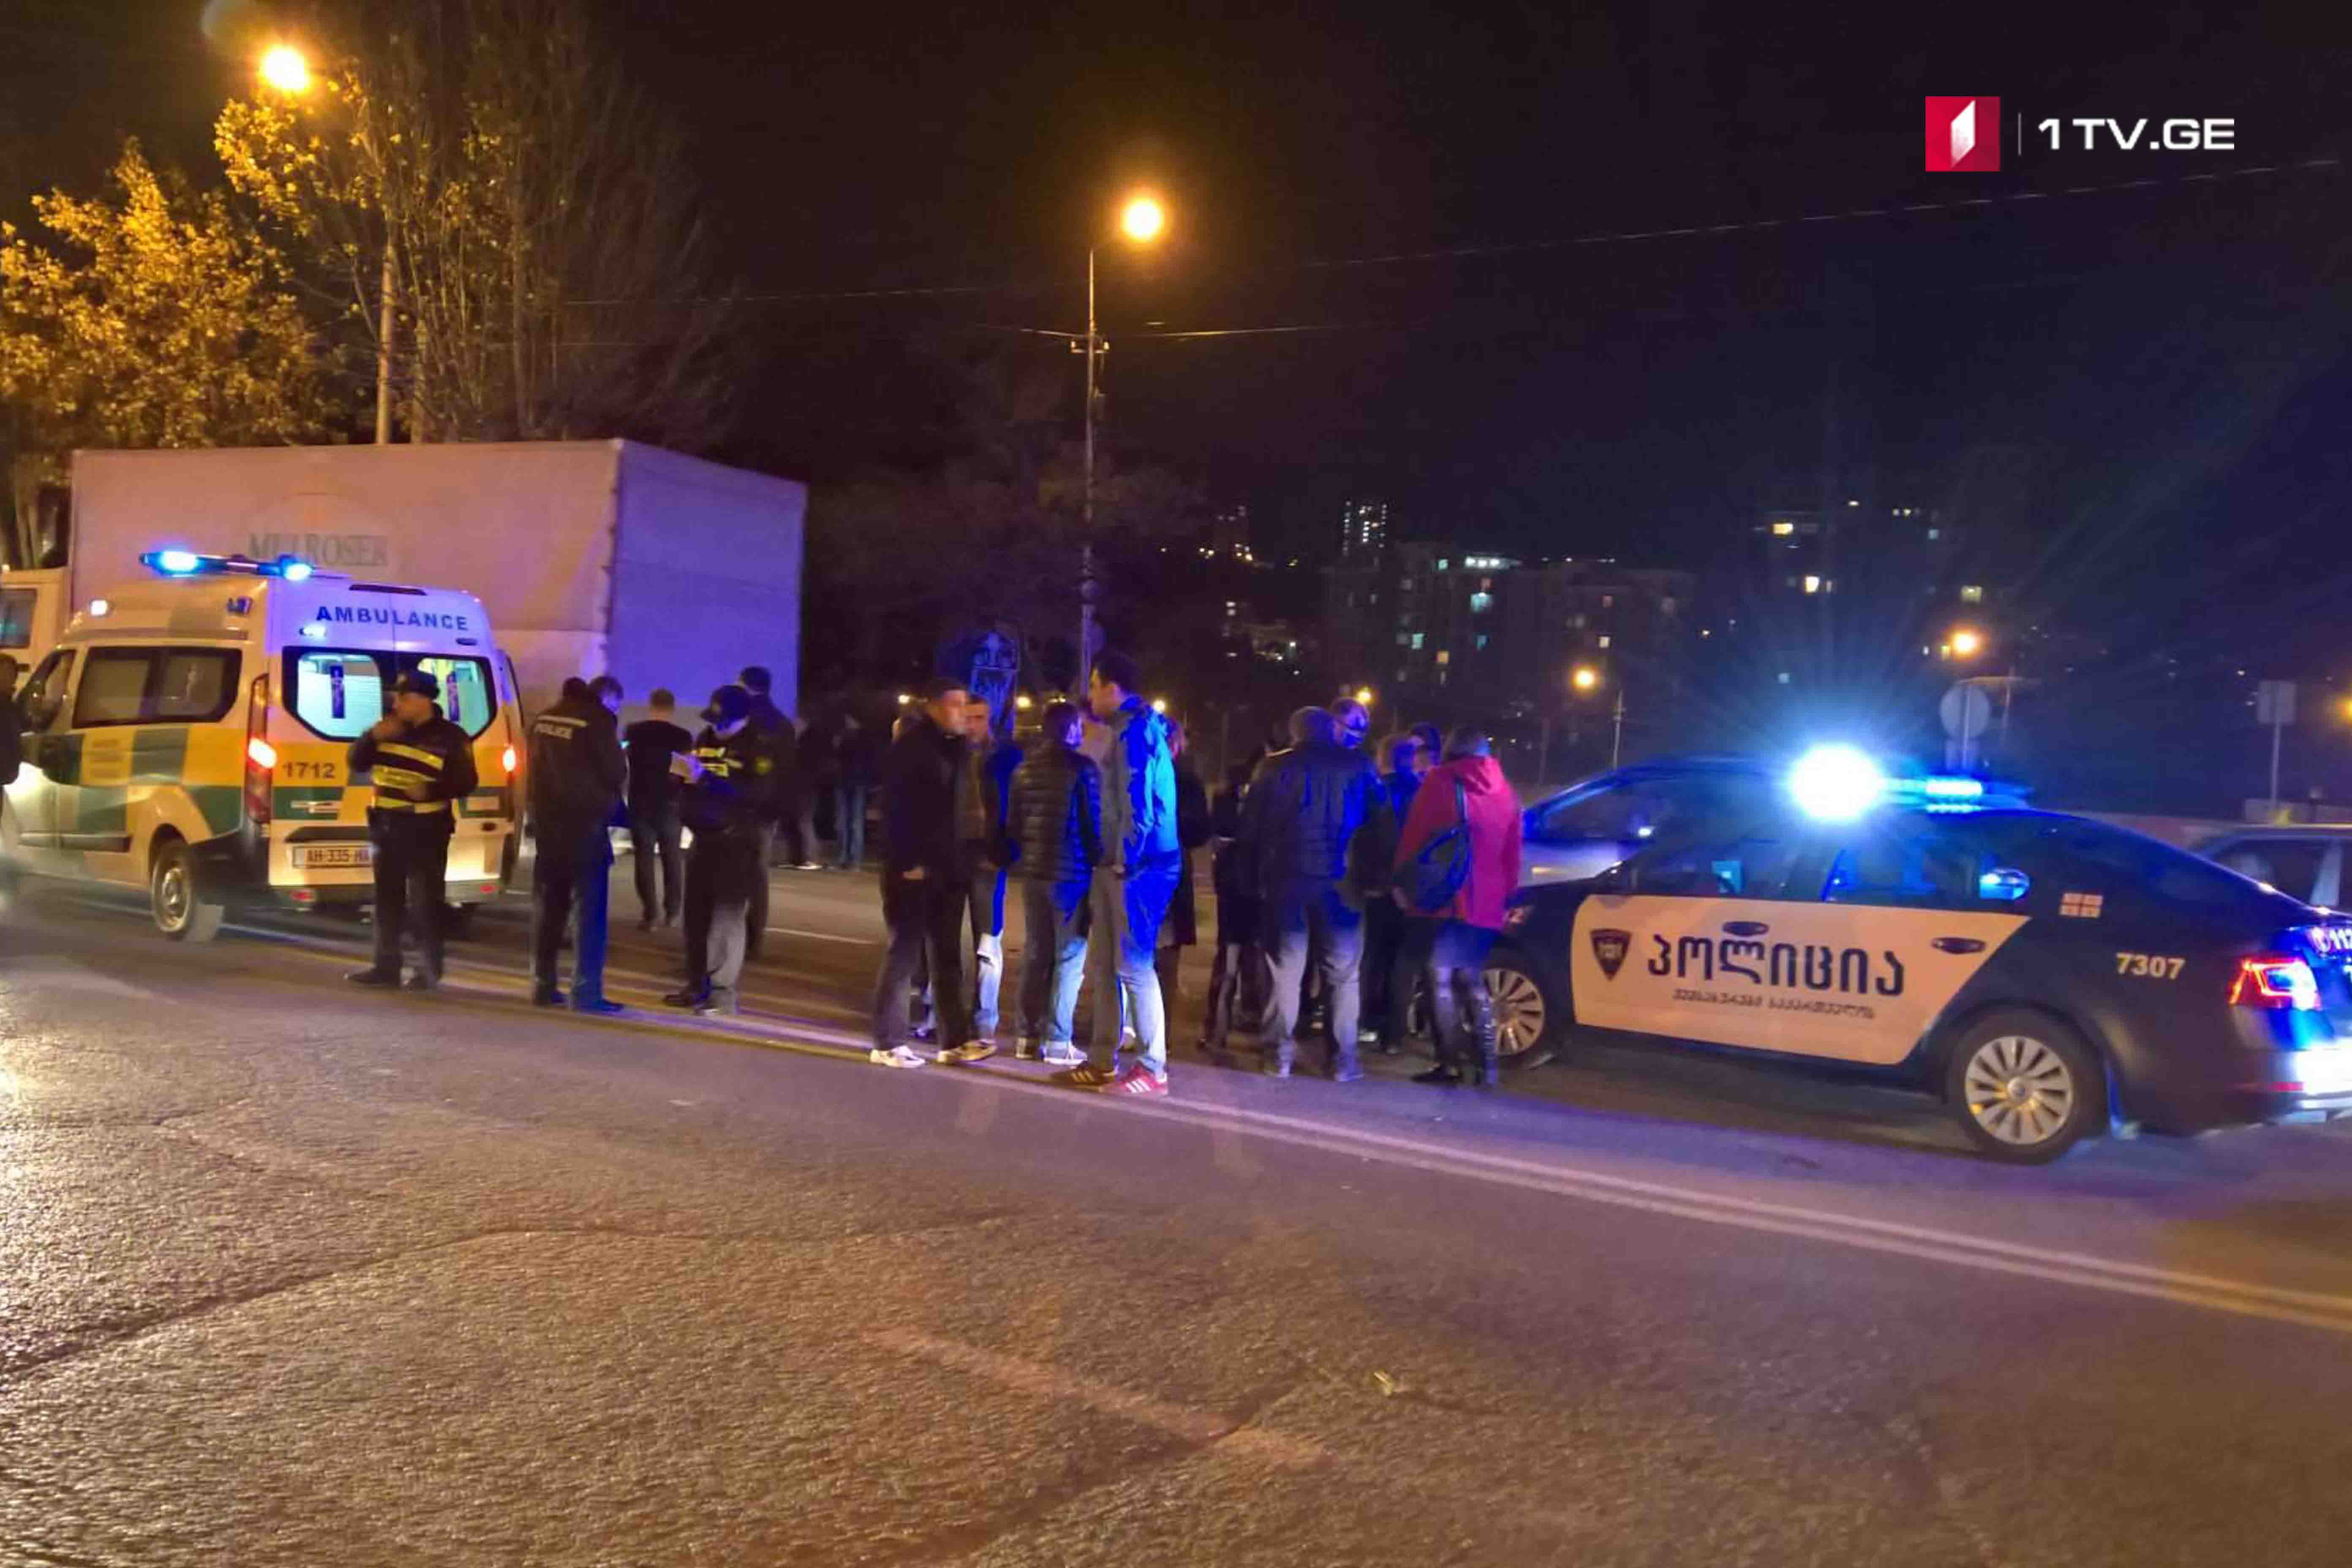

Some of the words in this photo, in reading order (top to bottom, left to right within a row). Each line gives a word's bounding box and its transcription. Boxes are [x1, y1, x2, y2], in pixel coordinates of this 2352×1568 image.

[316, 606, 469, 631] AMBULANCE
[282, 762, 335, 779] 1712
[1647, 934, 1905, 996] პოლიცია
[2115, 953, 2185, 980] 7307
